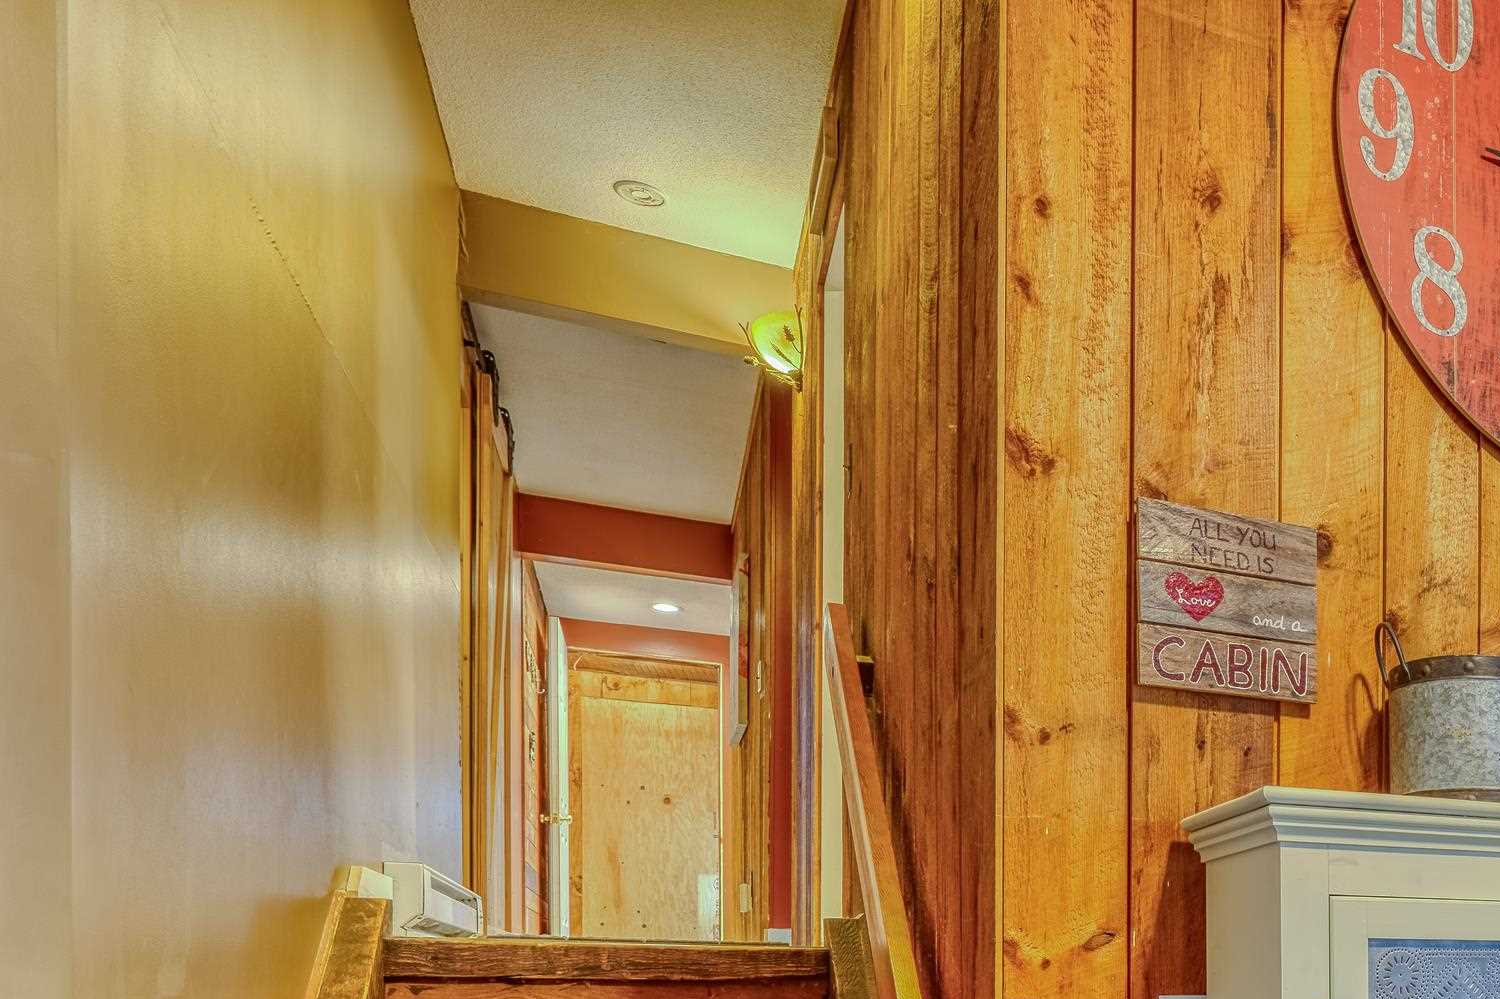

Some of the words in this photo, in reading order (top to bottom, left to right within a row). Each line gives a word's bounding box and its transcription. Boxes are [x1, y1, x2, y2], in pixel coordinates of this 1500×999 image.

[1358, 68, 1414, 181] 9
[1411, 226, 1468, 337] 8
[1186, 518, 1230, 542] ALL
[1237, 527, 1276, 551] YOU
[1191, 543, 1250, 570] NEED
[1257, 555, 1274, 574] IS
[1176, 587, 1216, 607] Love
[1252, 615, 1286, 631] and
[1291, 620, 1307, 632] a
[1152, 635, 1308, 696] CABIN
